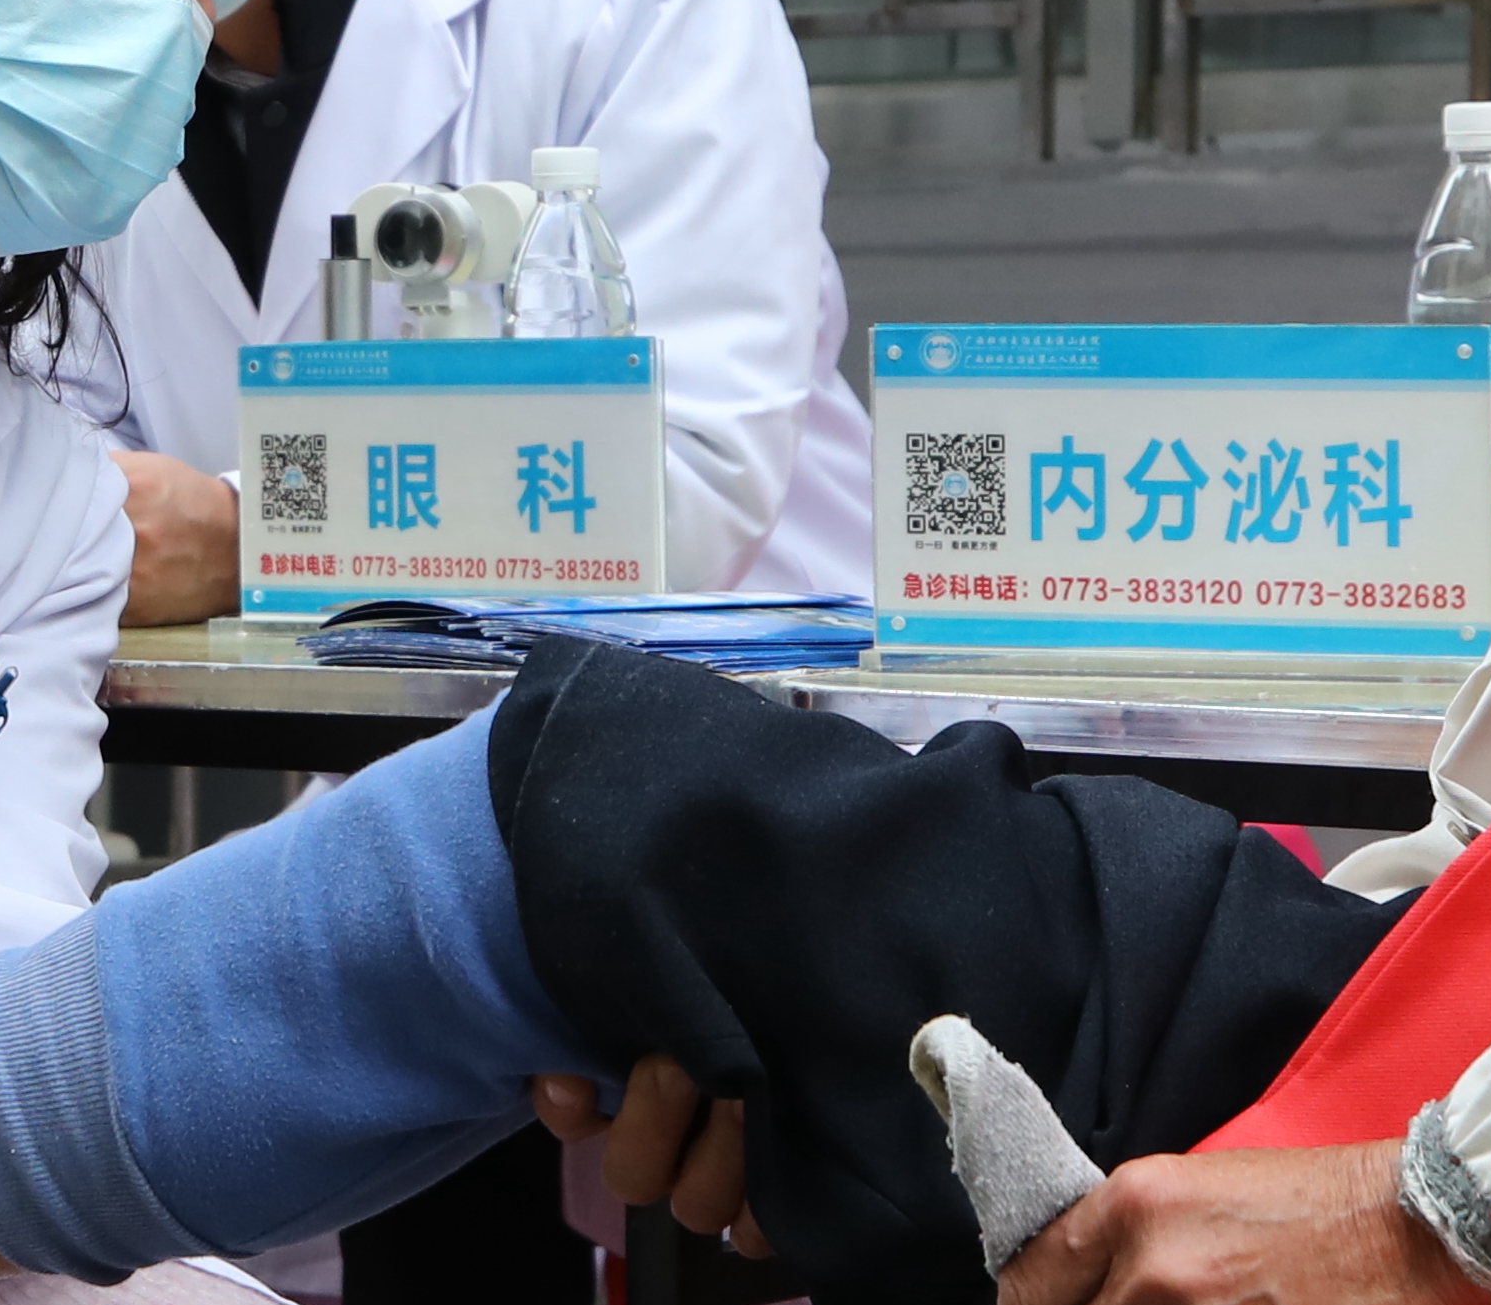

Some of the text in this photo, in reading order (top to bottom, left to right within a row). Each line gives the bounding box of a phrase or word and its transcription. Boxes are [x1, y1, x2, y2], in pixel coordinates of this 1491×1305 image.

[1029, 434, 1413, 548] 内分泌科
[353, 556, 488, 581] 0773-3833120
[496, 557, 641, 583] 0773-3832683
[1042, 576, 1244, 606] 0773-3833120
[1256, 579, 1468, 611] 0773-3832683
